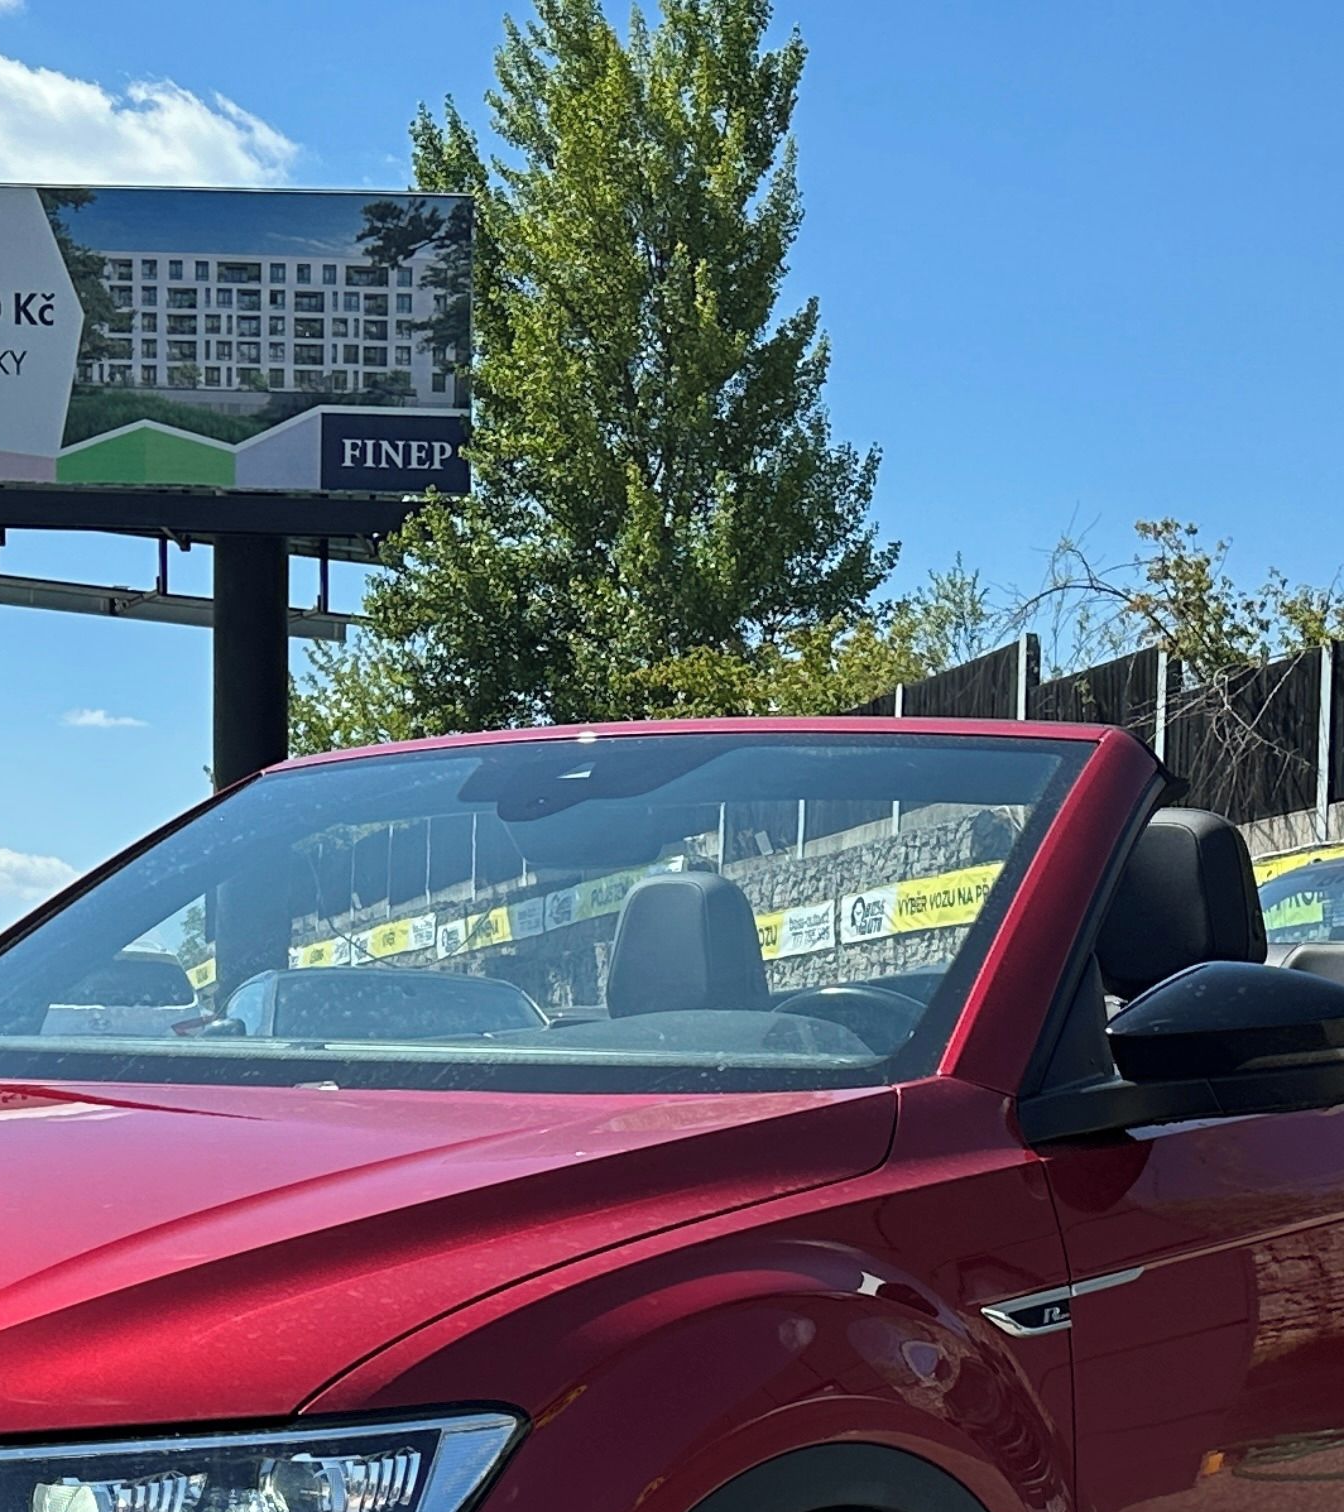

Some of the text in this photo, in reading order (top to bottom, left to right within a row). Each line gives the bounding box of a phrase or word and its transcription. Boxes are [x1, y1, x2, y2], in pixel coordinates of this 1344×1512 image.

[14, 292, 56, 326] Kč
[341, 438, 453, 470] FINEP
[958, 887, 973, 905] NA
